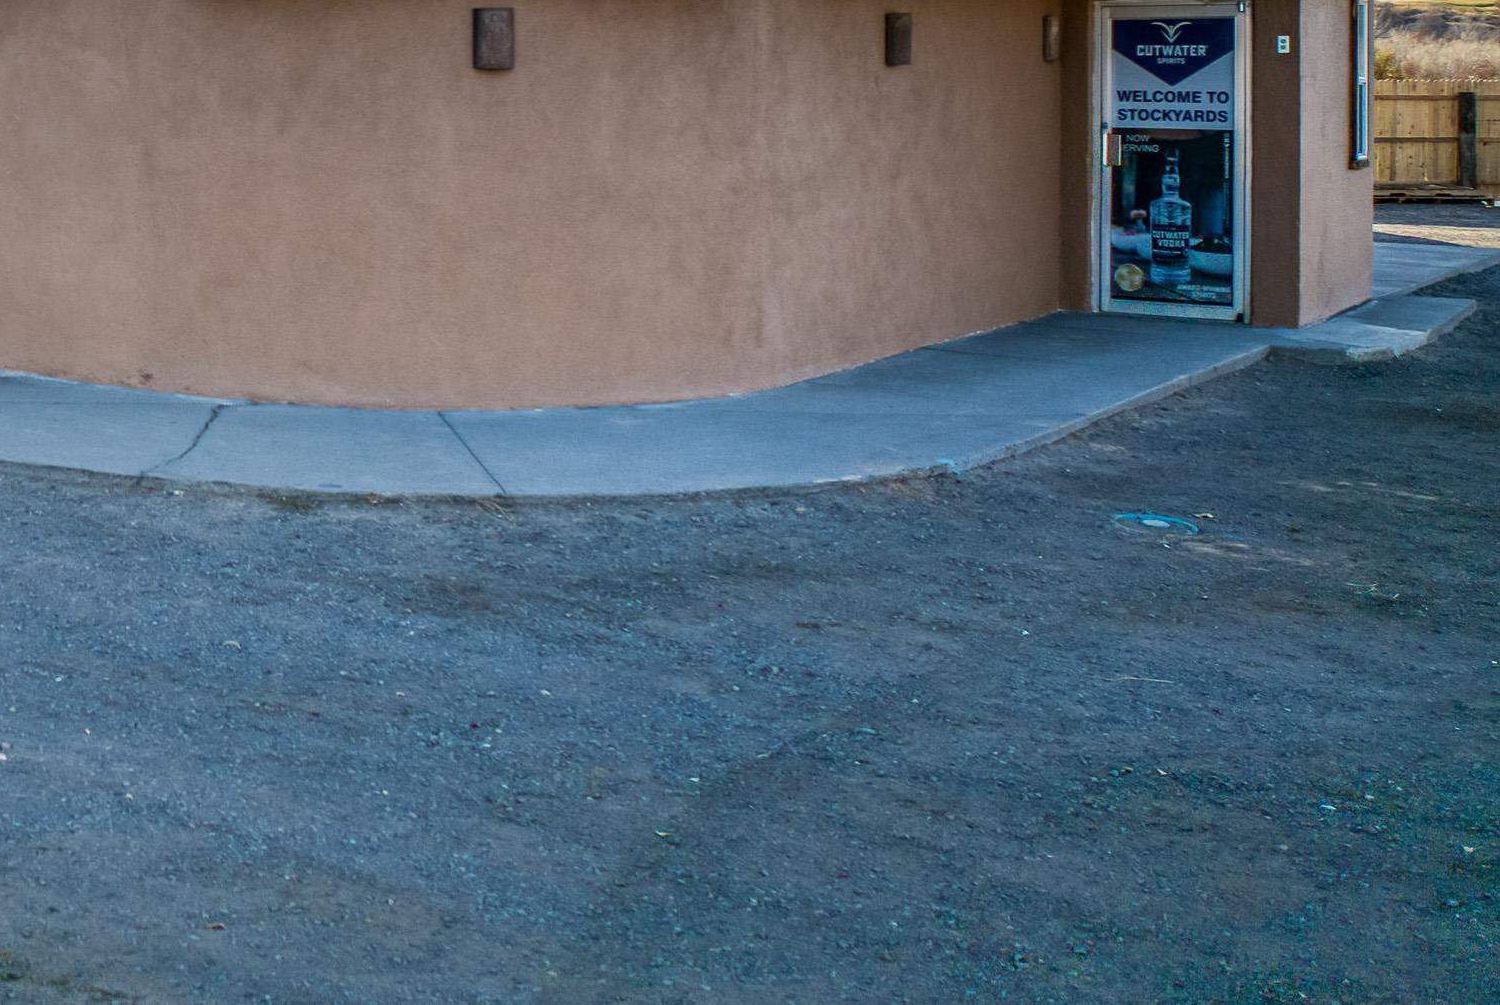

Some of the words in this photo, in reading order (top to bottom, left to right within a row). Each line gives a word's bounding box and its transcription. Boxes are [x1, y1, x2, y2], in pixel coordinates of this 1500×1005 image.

[1136, 44, 1207, 57] CUTWATER
[1157, 57, 1186, 65] SPIRITS
[1117, 90, 1202, 103] WELCOME
[1206, 91, 1230, 104] TO
[1117, 108, 1229, 123] STOCKYARDS
[1125, 134, 1151, 143] NOW
[1122, 144, 1160, 153] ERVING
